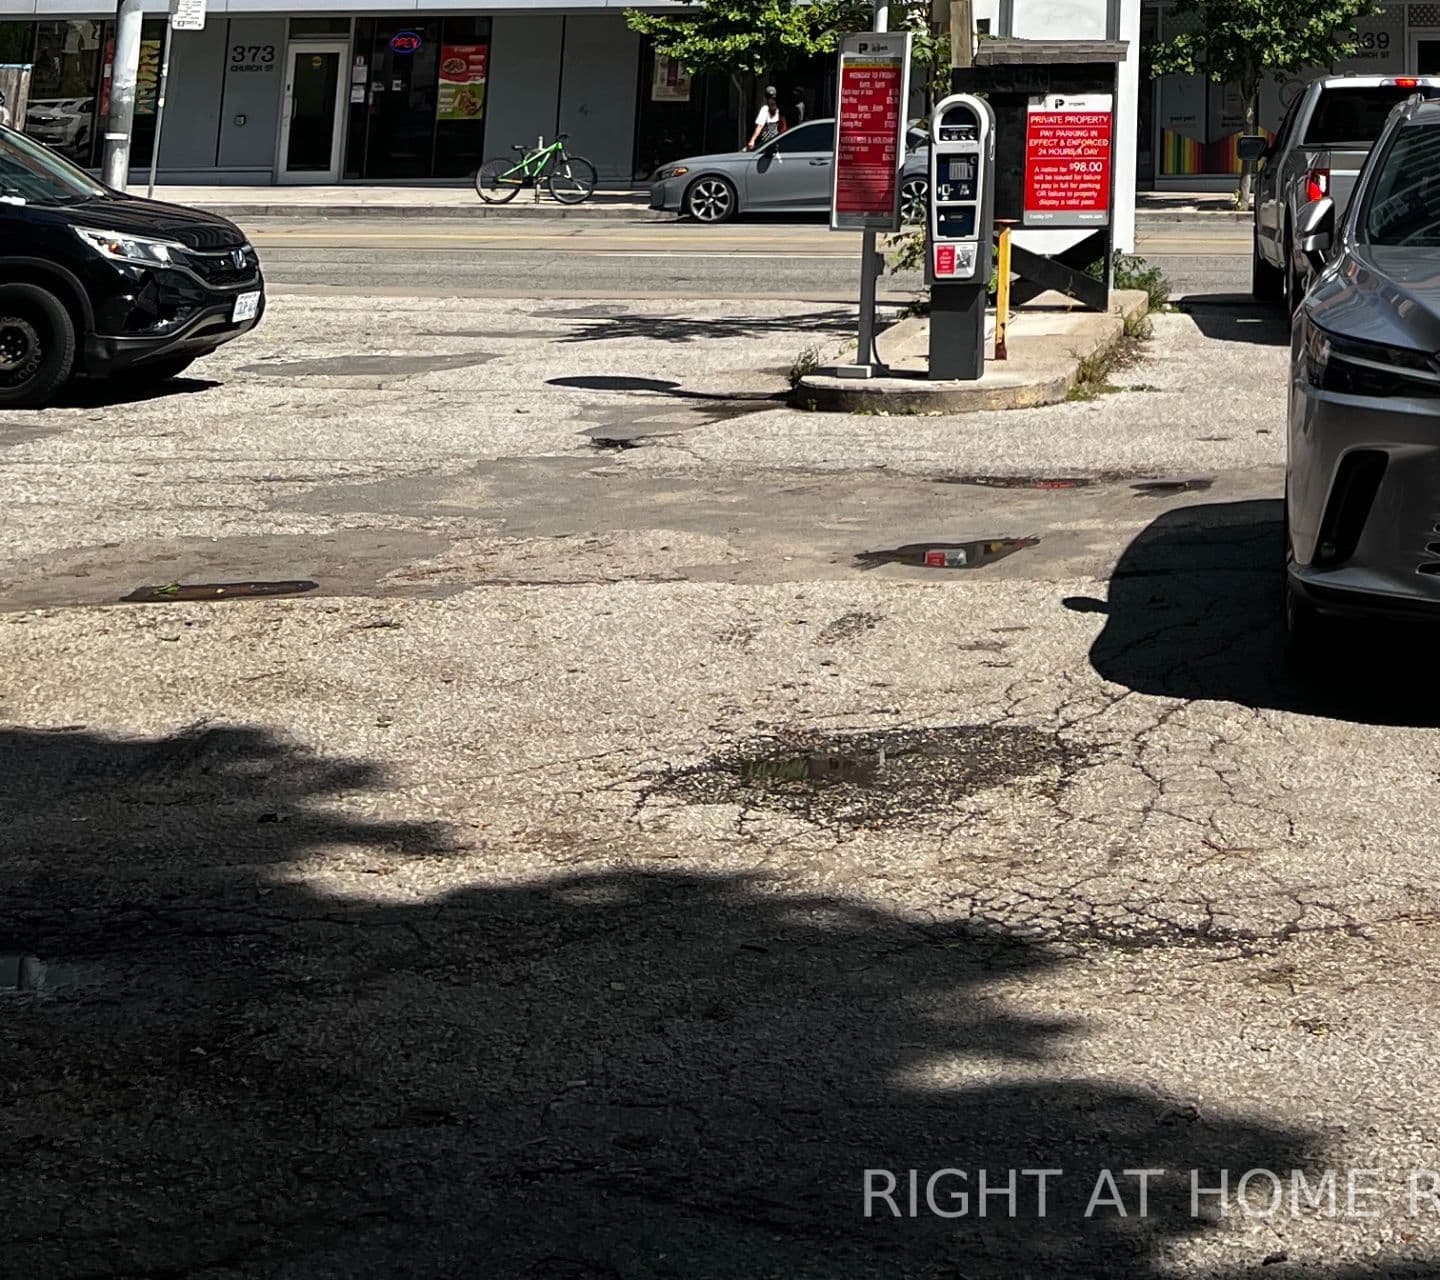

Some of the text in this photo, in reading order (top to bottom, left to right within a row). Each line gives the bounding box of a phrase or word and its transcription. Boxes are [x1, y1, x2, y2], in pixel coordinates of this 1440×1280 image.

[231, 45, 275, 63] 373
[1030, 115, 1109, 124] PRIVATE PROPERTY
[1040, 129, 1098, 137] PAY PARKING IN
[1029, 138, 1058, 147] EFFECT
[1066, 138, 1109, 147] ENFORCED
